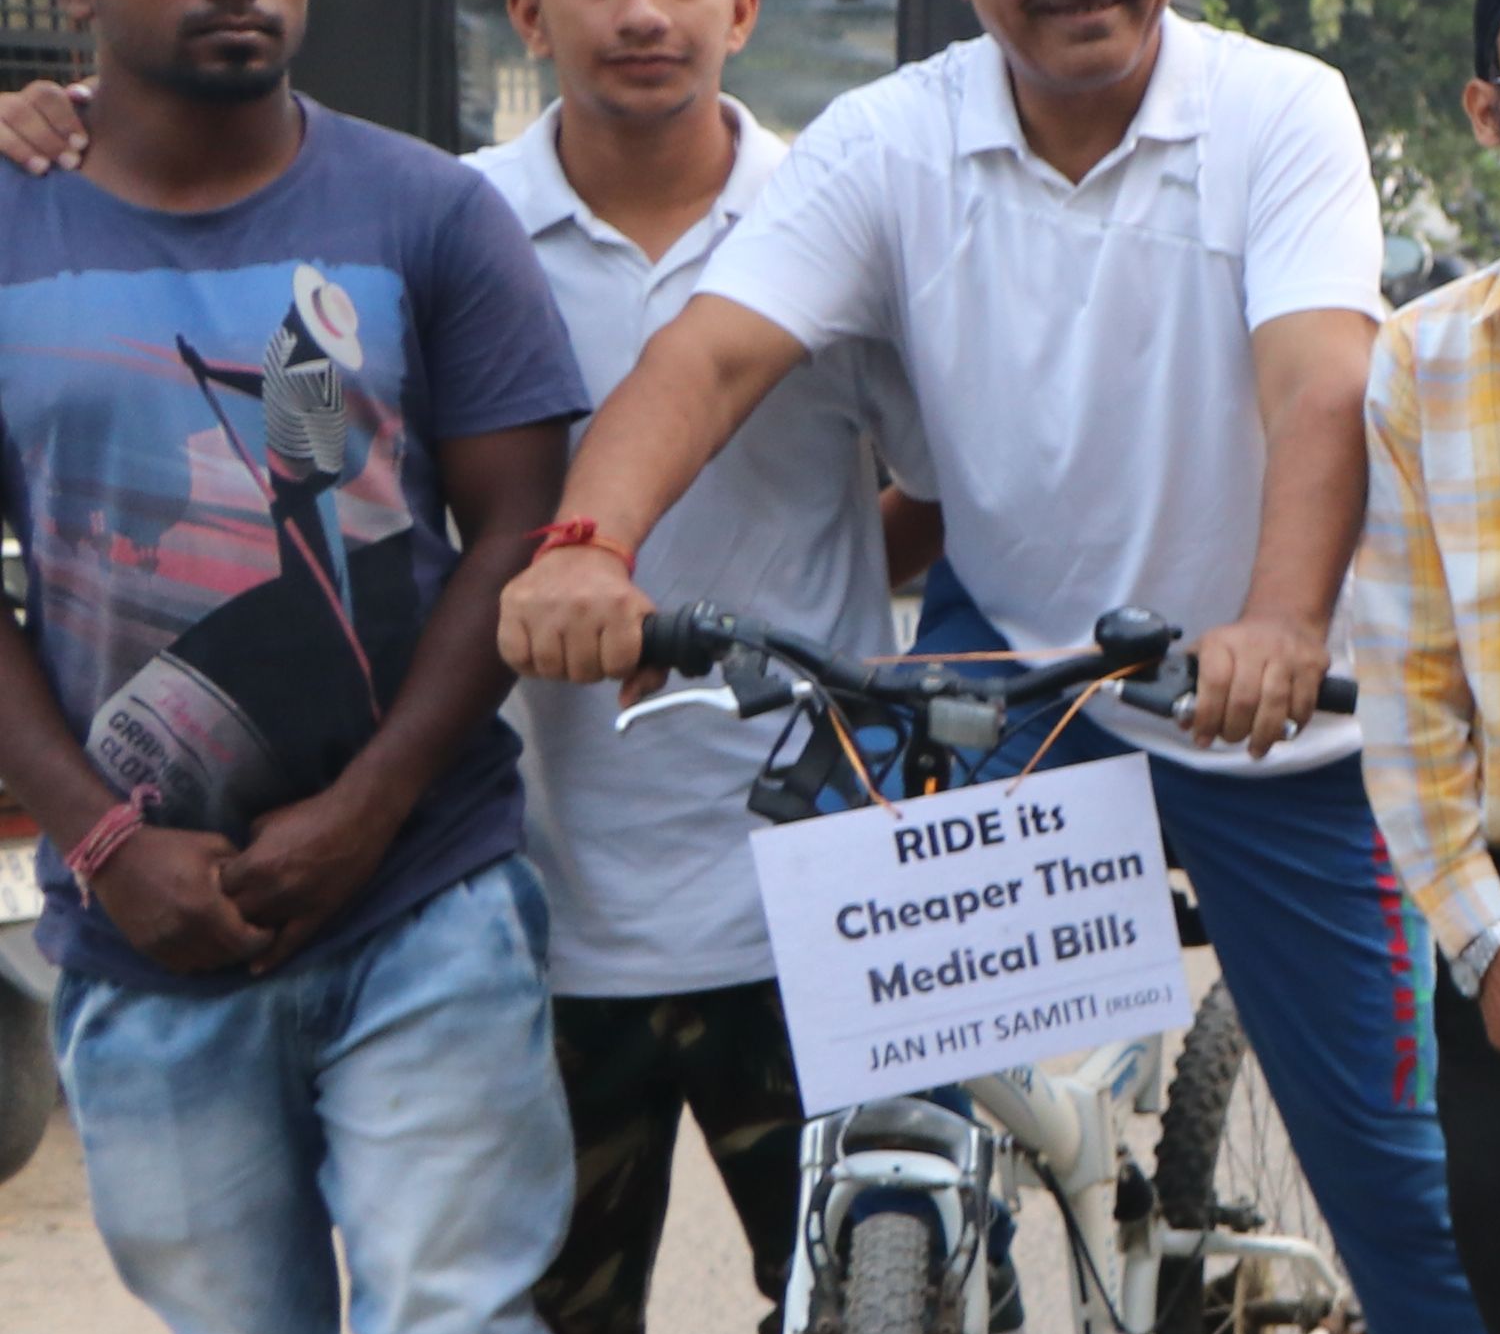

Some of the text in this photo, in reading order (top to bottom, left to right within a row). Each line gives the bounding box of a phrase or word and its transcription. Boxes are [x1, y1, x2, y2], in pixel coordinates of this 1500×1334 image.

[894, 803, 1066, 864] RIDE its
[835, 851, 1144, 941] Cheaper Than
[867, 912, 1138, 1004] Medical Bills
[869, 1035, 927, 1072] JAN
[936, 1021, 984, 1056] HIT
[994, 994, 1100, 1042] SAMITI
